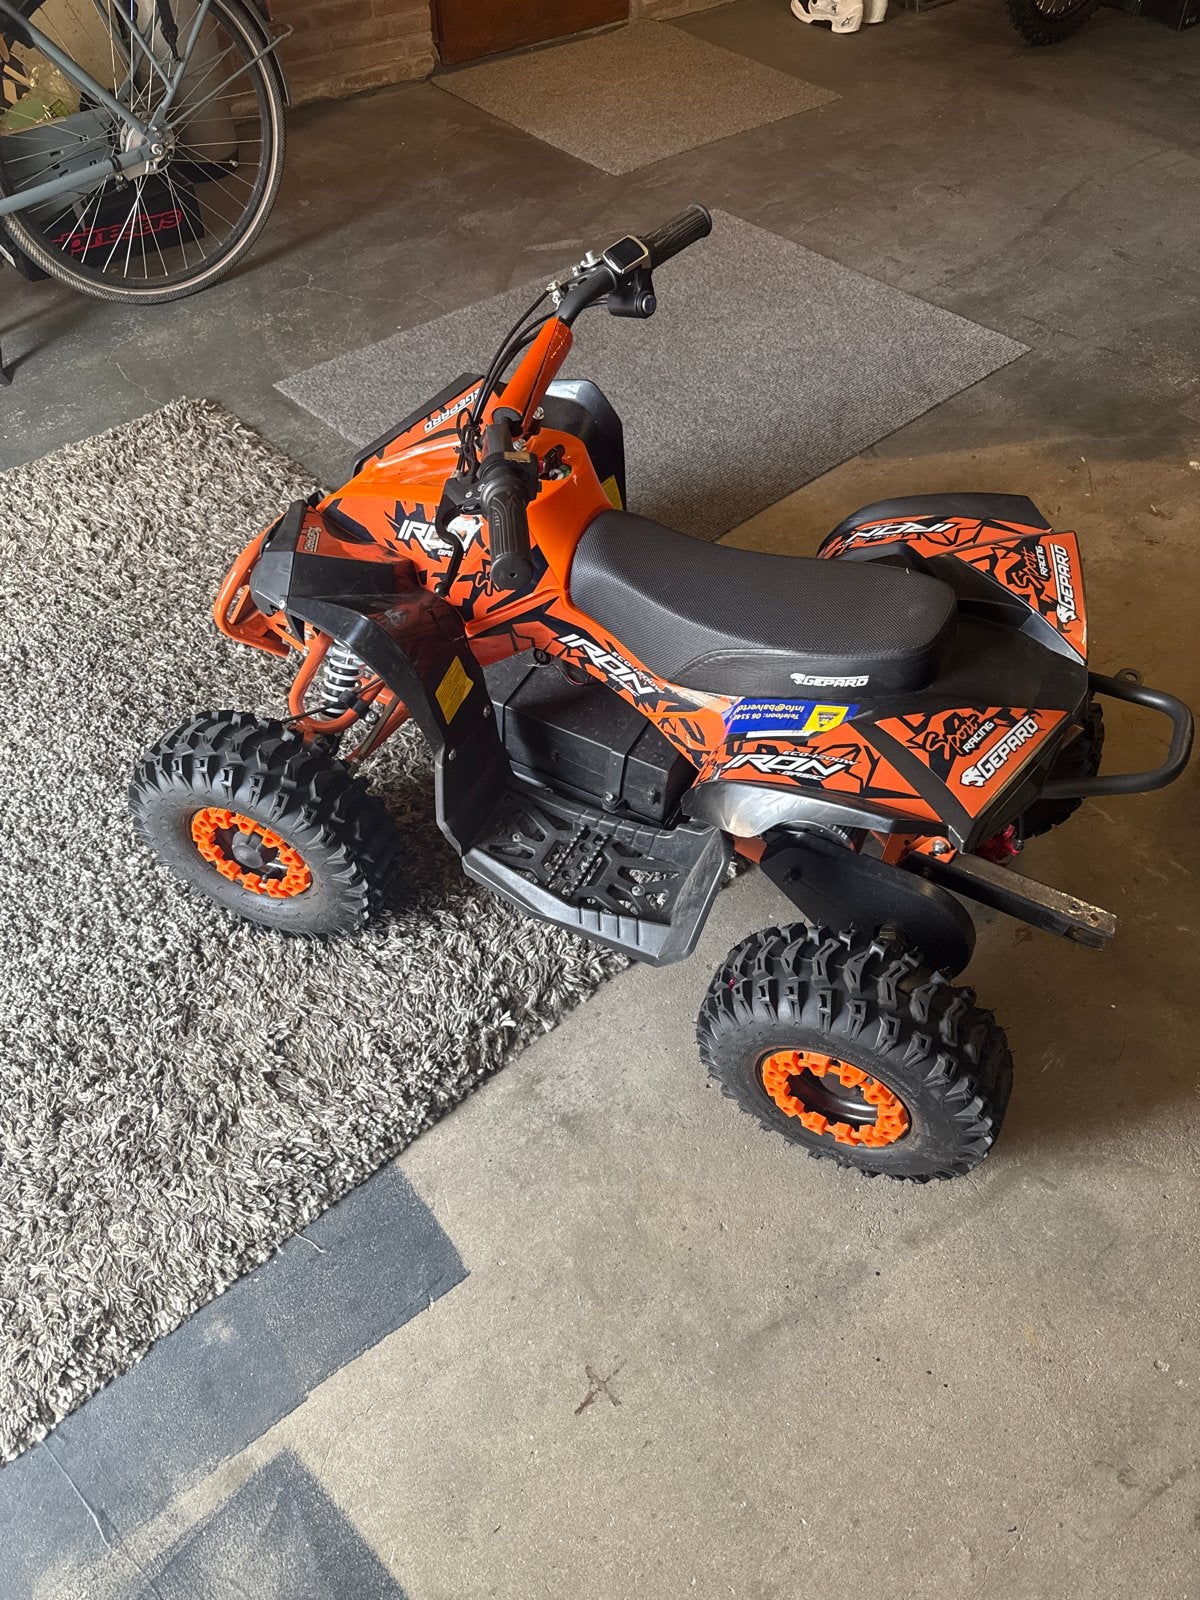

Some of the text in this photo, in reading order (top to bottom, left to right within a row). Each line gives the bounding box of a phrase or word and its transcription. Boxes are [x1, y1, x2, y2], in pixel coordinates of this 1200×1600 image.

[424, 391, 475, 434] GEPARD
[845, 521, 957, 545] IRON
[1035, 545, 1049, 577] RACING
[1049, 543, 1075, 612] GEPARD
[557, 633, 656, 695] IRON
[803, 675, 870, 688] GEPARD
[925, 716, 979, 760] Sport
[962, 721, 995, 753] RACING
[976, 715, 1039, 780] GEPARD
[722, 753, 847, 777] IRON
